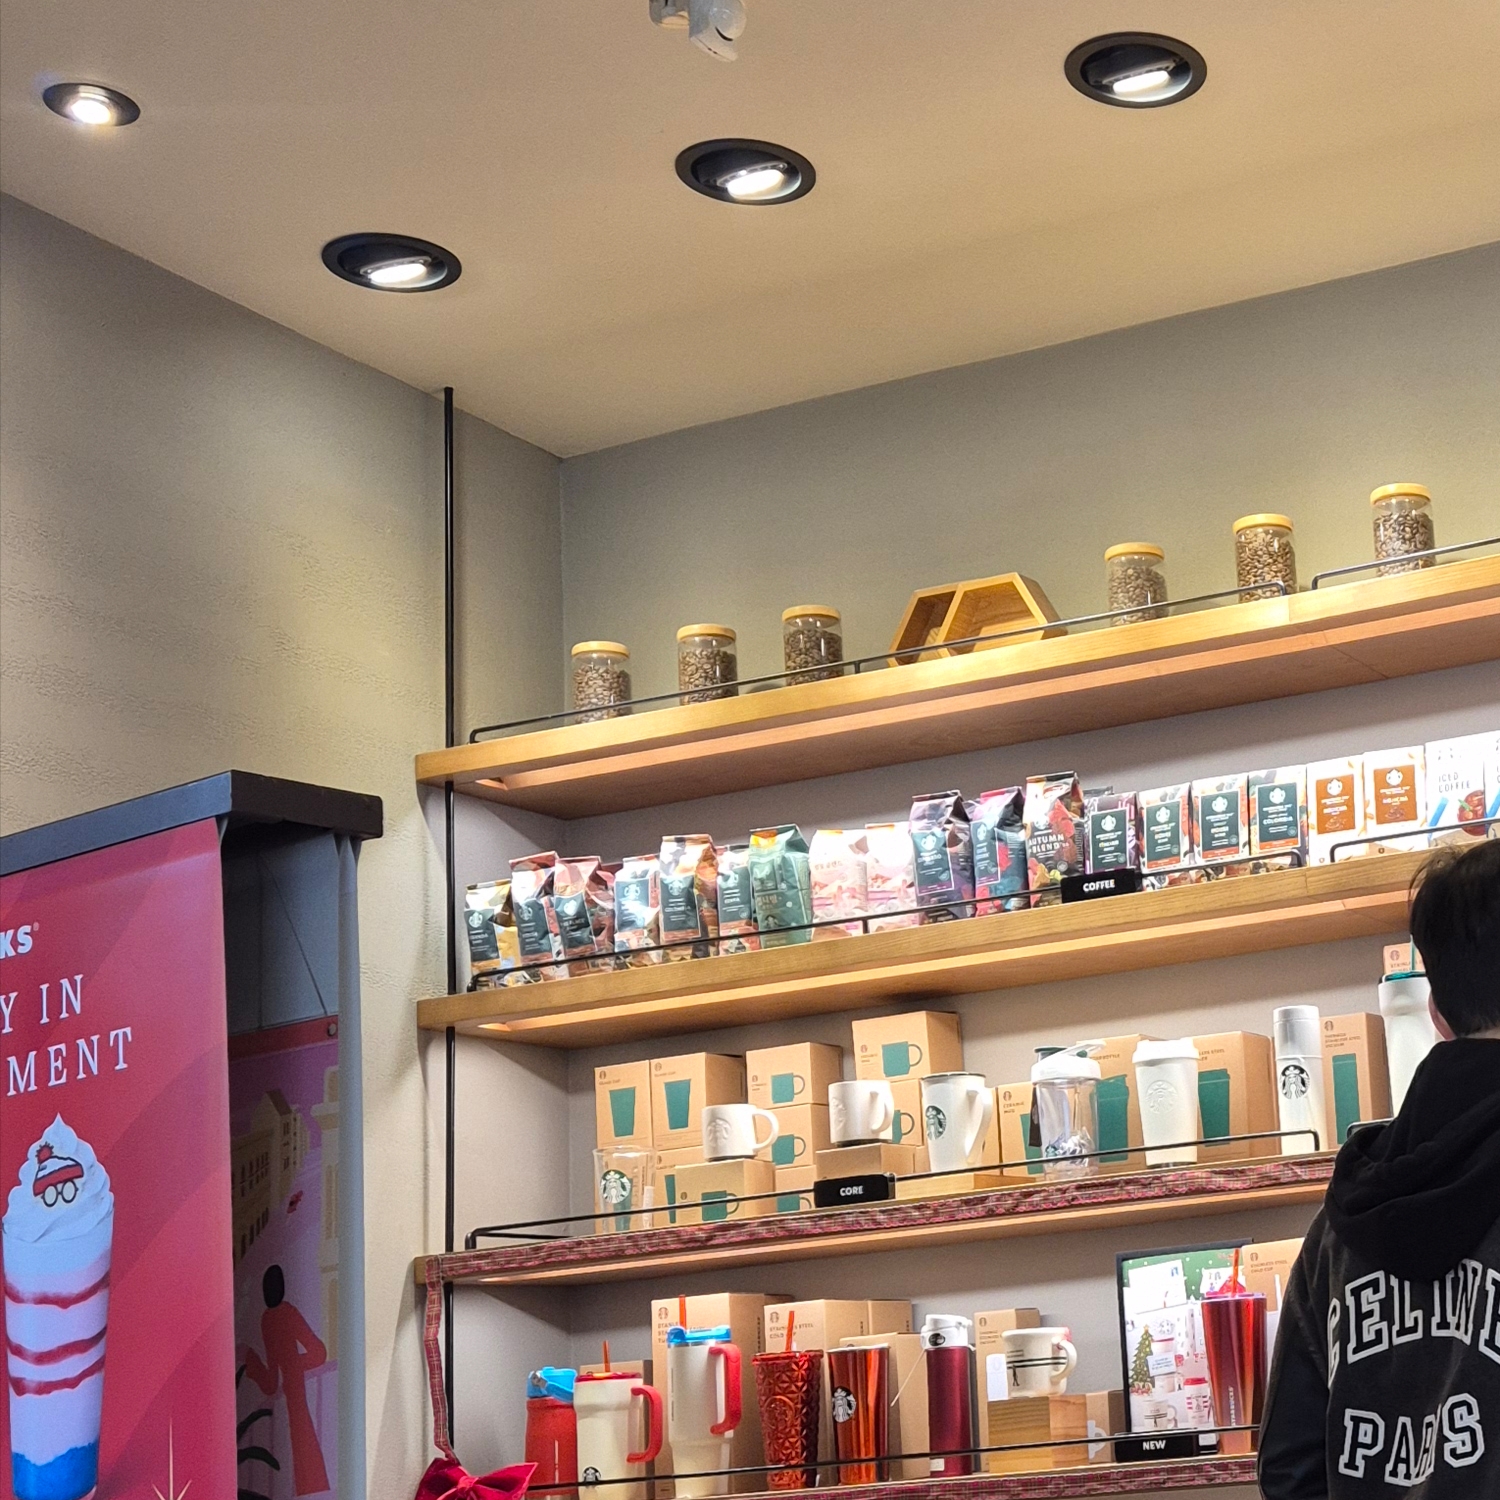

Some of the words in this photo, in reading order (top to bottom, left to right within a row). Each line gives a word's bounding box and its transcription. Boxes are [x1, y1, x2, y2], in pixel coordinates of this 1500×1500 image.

[1082, 879, 1116, 892] COFFEE
[39, 974, 83, 1024] IN
[7, 1026, 132, 1096] MENT
[838, 1186, 864, 1197] CORE
[1143, 1439, 1166, 1451] NEW
